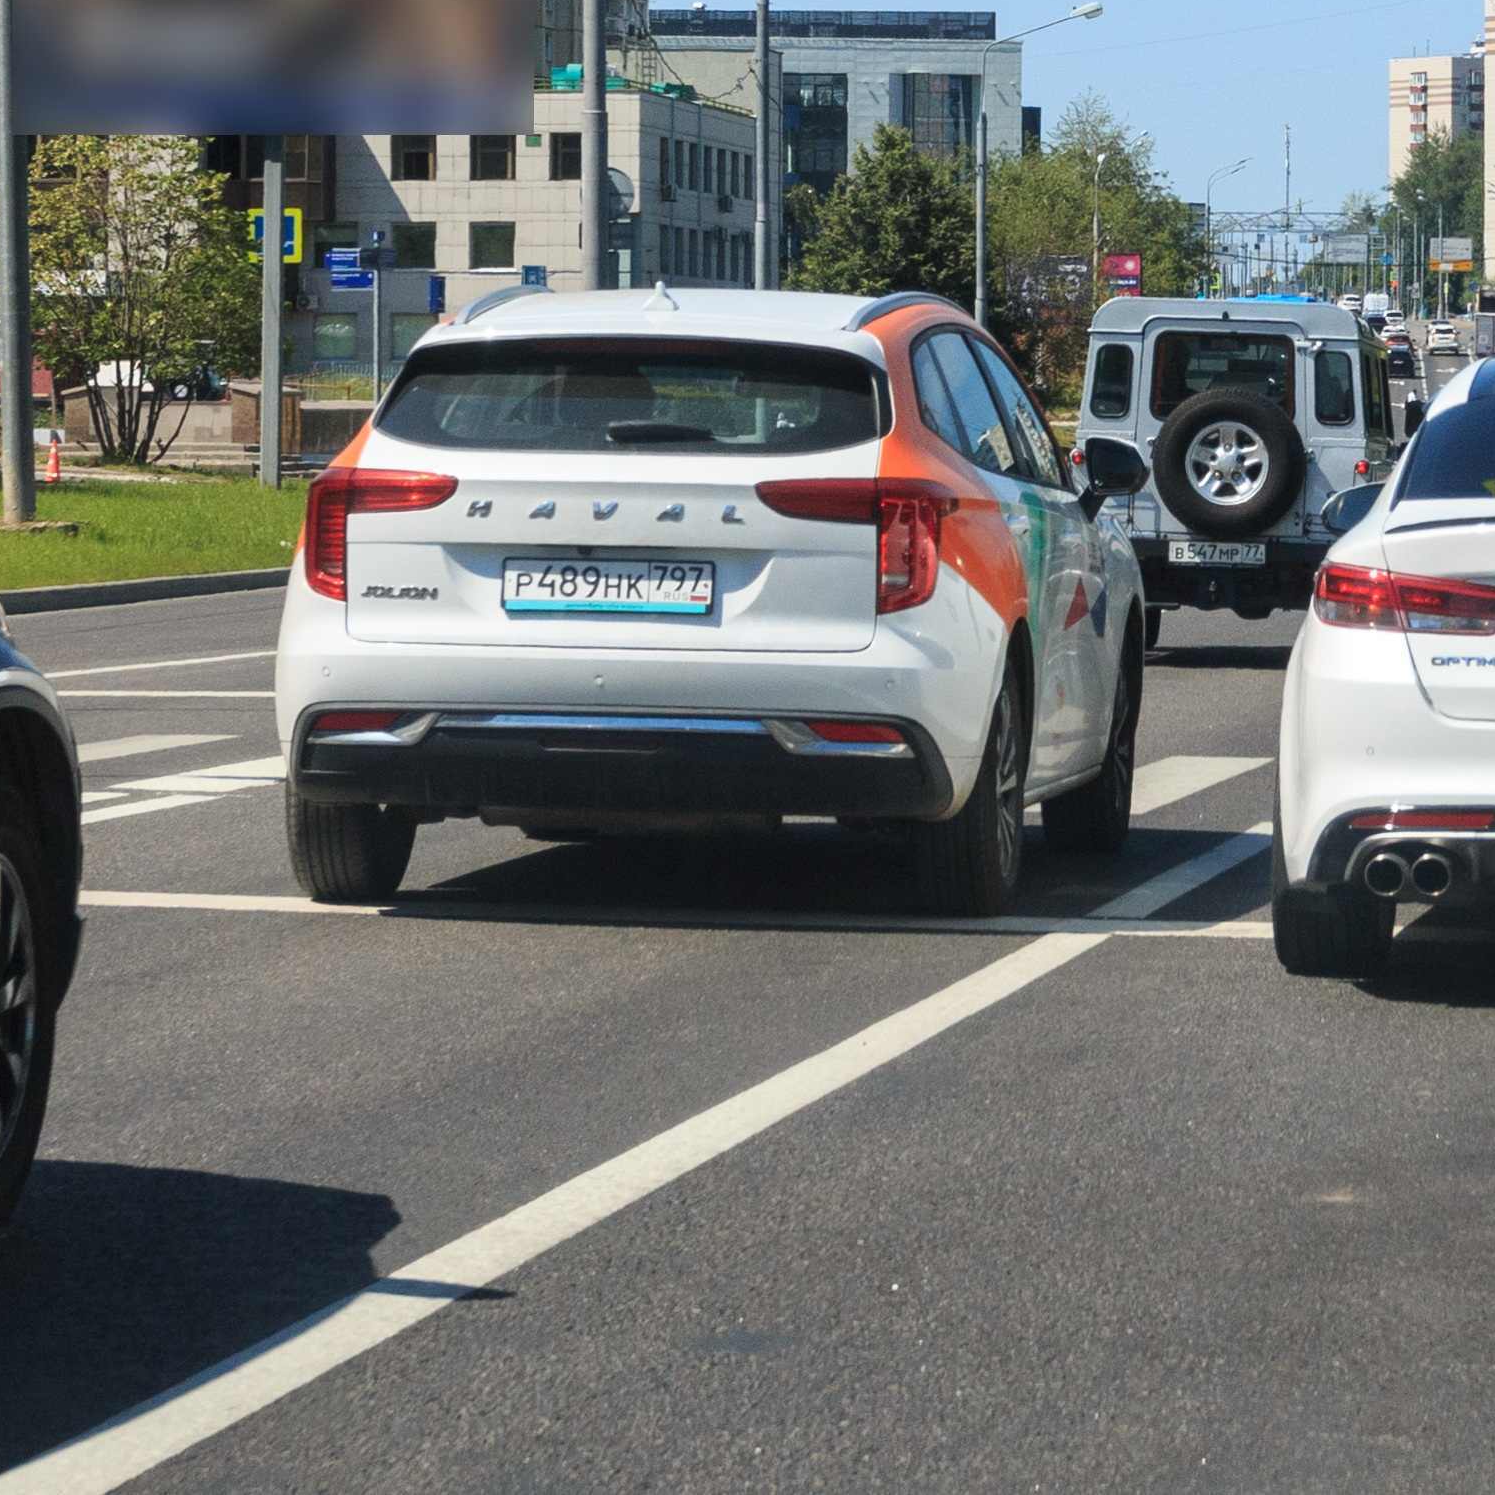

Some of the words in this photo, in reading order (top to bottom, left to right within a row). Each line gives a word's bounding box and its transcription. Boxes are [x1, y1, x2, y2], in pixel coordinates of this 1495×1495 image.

[466, 500, 745, 525] HAVAL
[1245, 546, 1260, 558] 77
[515, 565, 644, 600] Р489НК
[653, 566, 704, 593] 797
[663, 592, 689, 601] RUS
